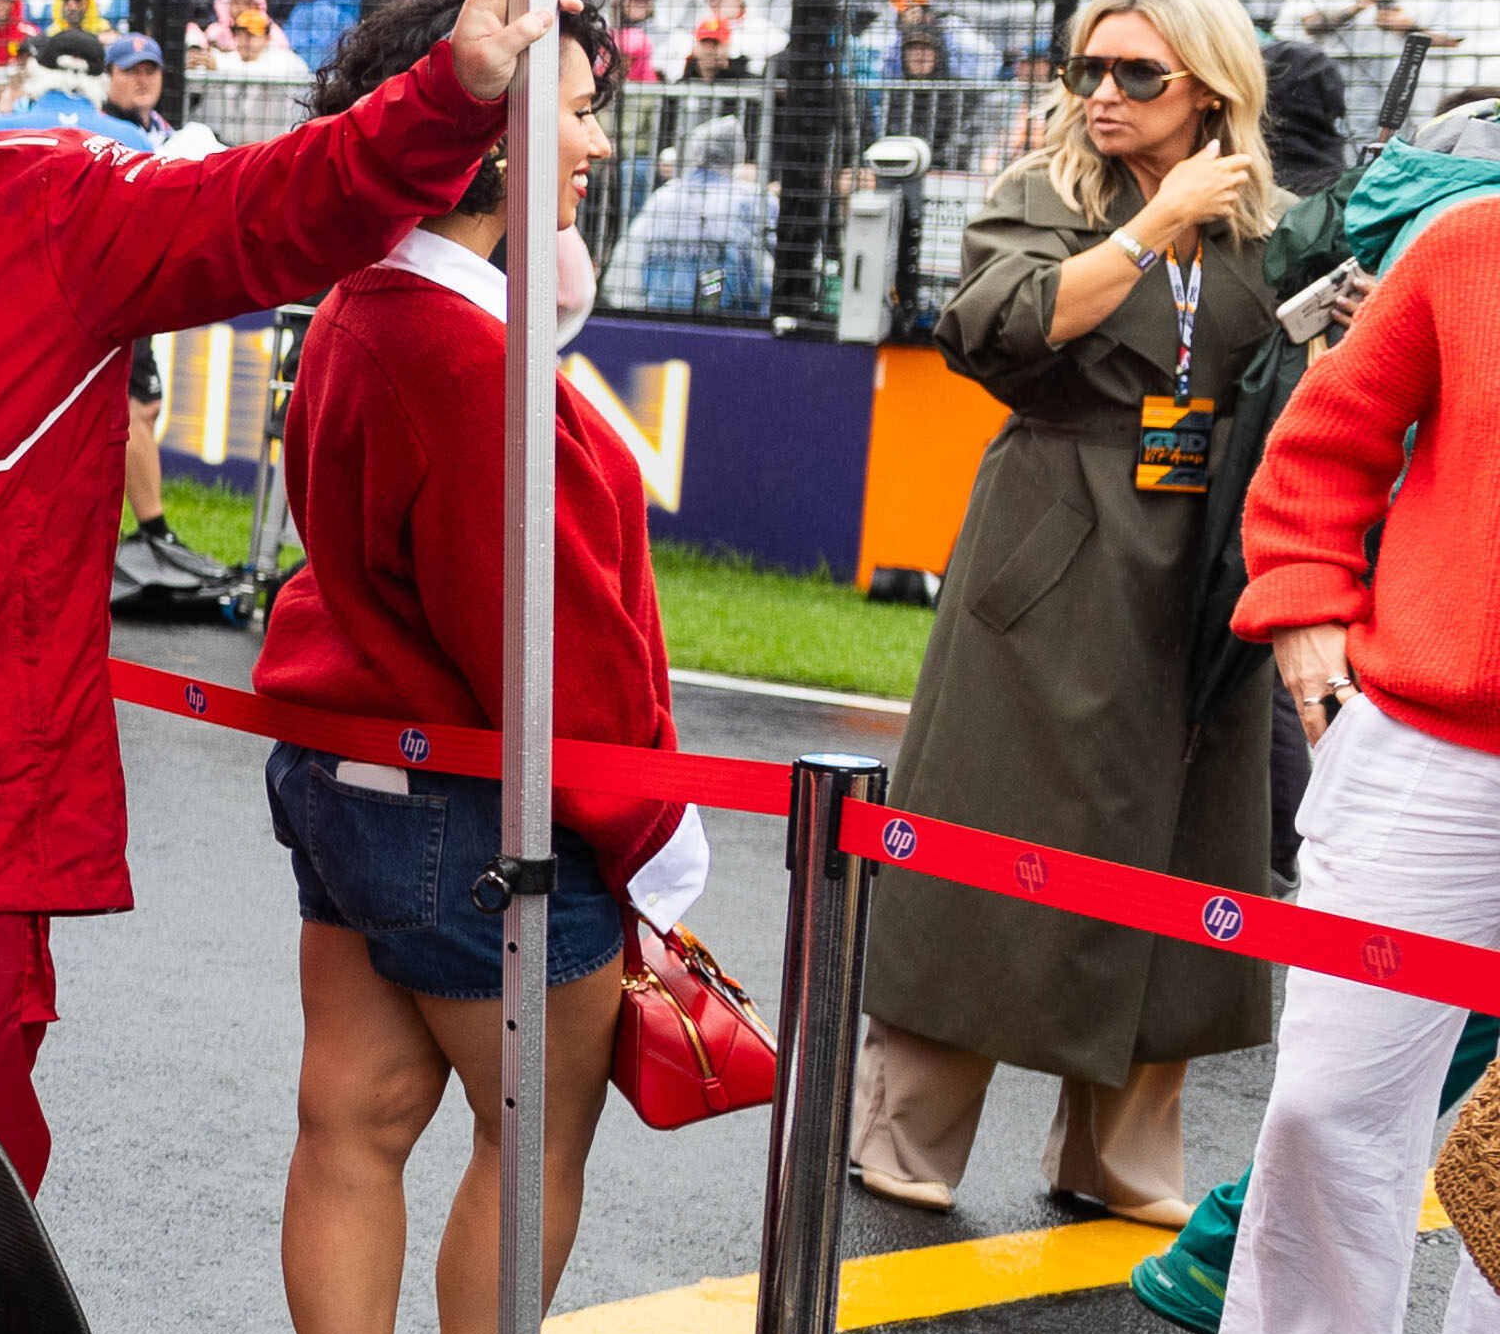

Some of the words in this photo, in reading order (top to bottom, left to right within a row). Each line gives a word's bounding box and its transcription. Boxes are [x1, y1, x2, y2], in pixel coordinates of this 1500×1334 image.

[186, 683, 206, 713] hp
[402, 728, 427, 762] hp
[885, 818, 914, 859] hp
[1205, 896, 1239, 940] hp
